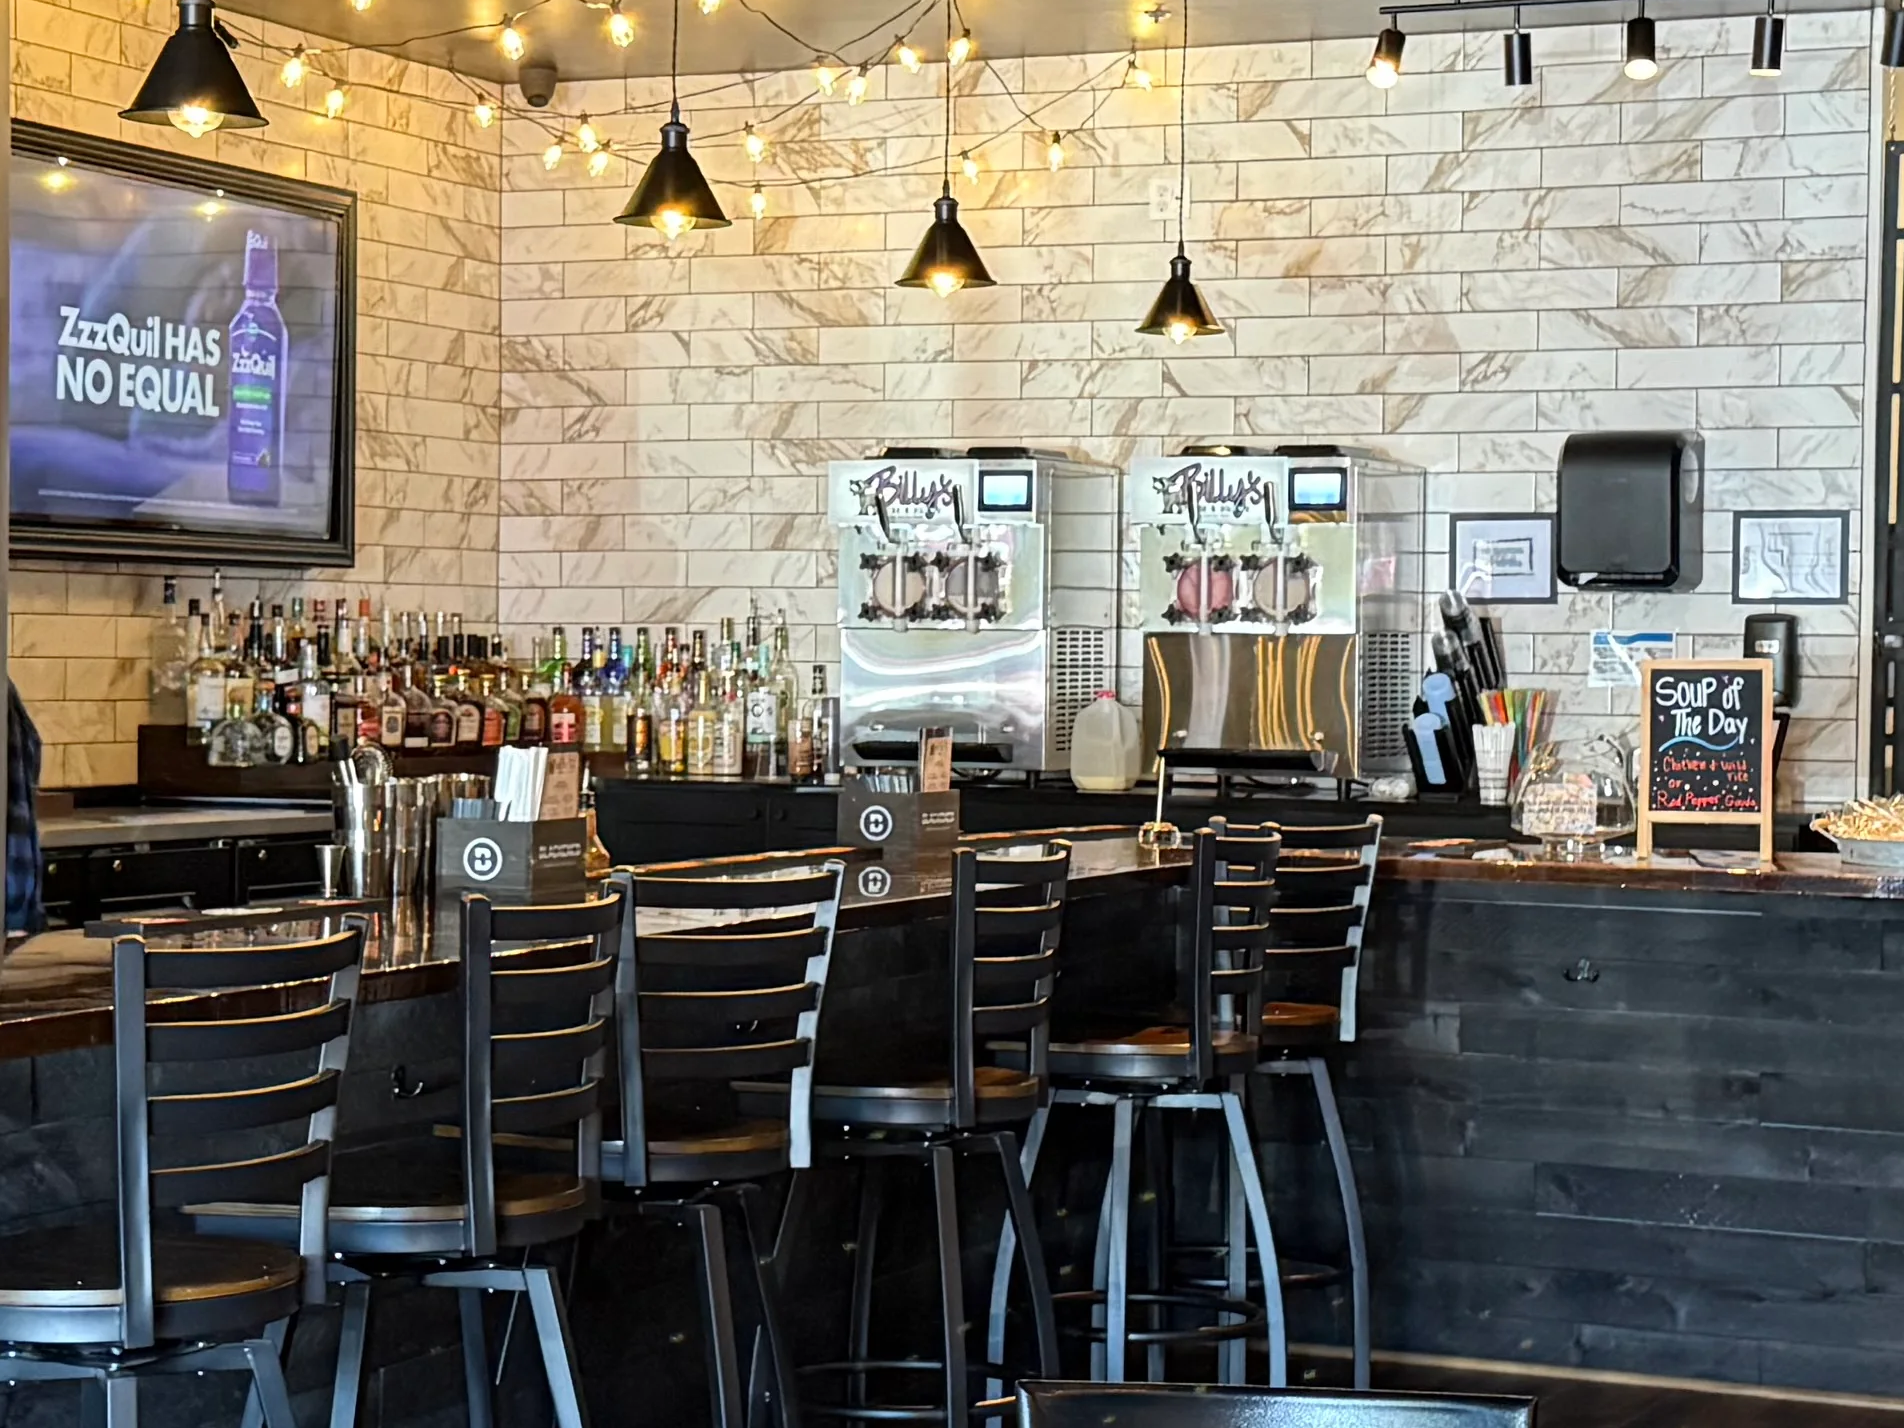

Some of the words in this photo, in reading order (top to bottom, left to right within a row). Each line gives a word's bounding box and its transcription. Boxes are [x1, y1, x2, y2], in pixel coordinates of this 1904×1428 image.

[58, 306, 160, 358] ZzzQuil
[165, 323, 221, 366] HAS
[56, 355, 113, 405] NO
[118, 362, 220, 417] EQUAL
[864, 465, 953, 519] Billy's
[1168, 462, 1264, 518] Billy's
[1722, 676, 1744, 711] of
[1670, 708, 1702, 737] The
[1708, 708, 1749, 745] Day
